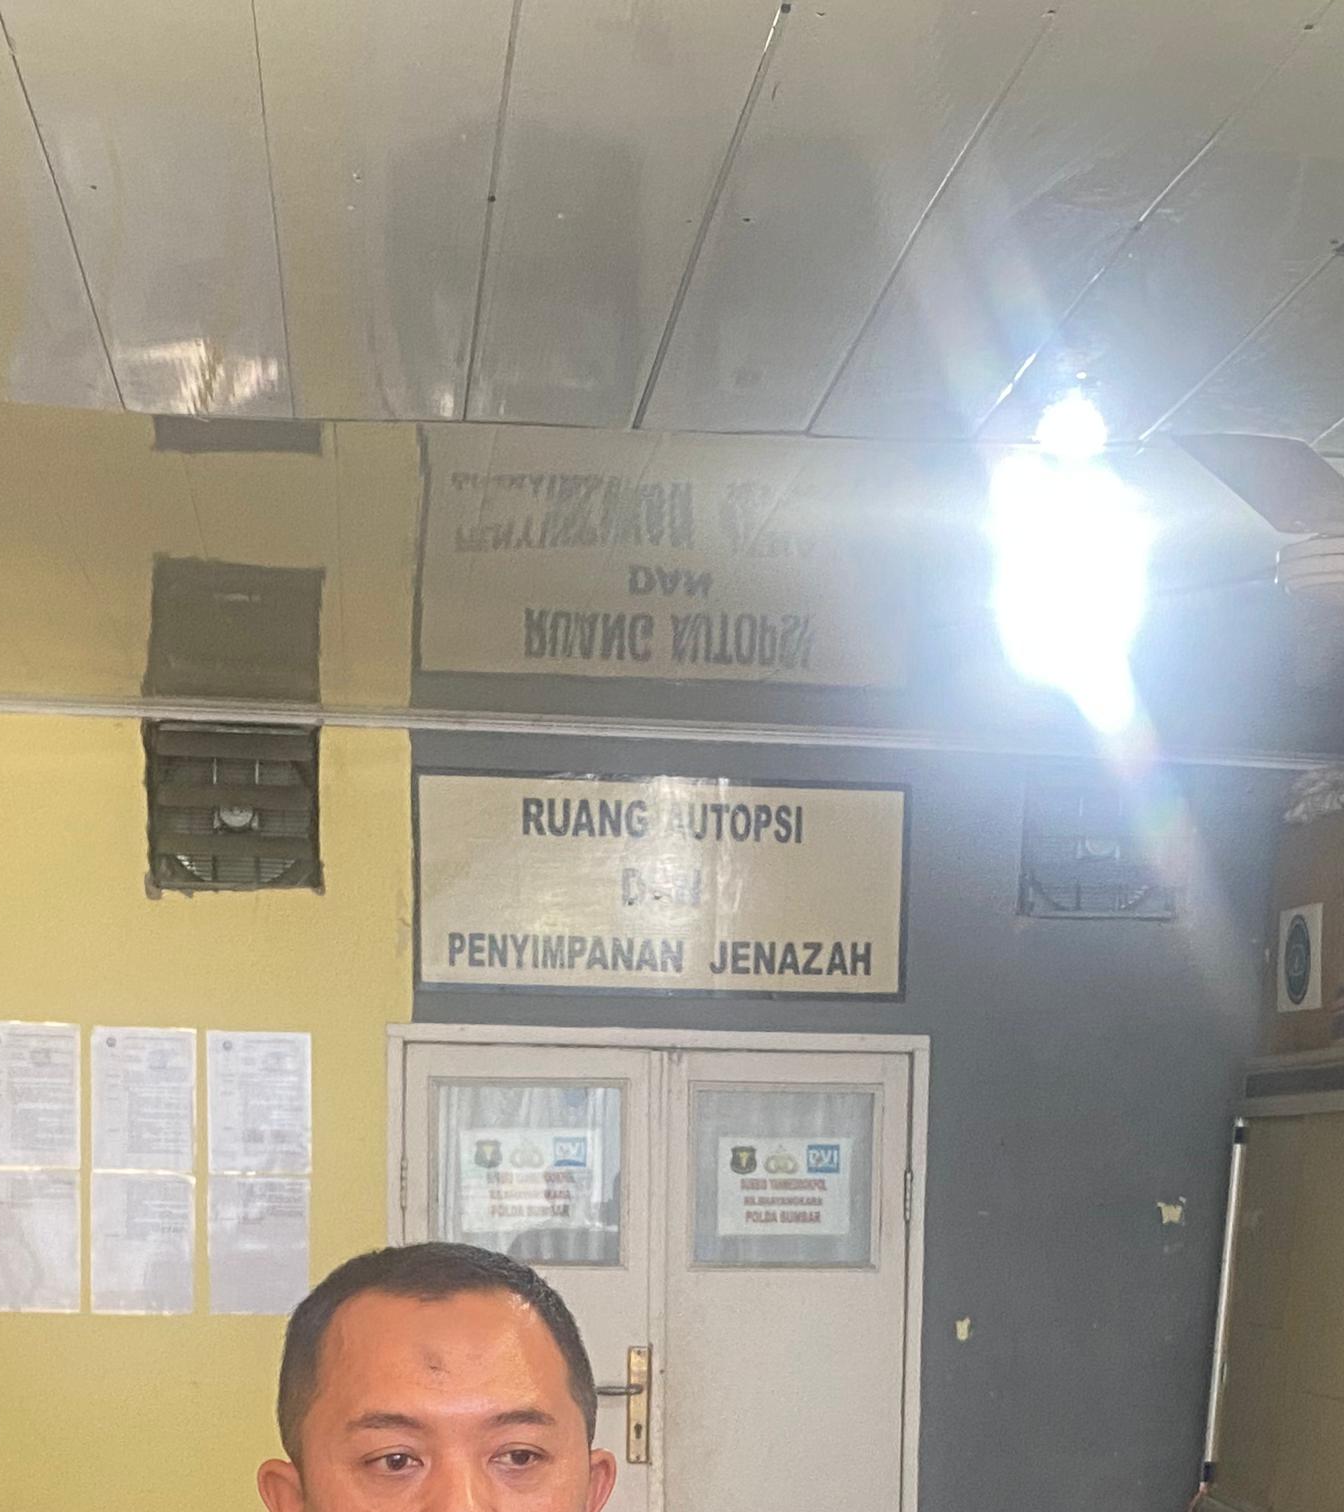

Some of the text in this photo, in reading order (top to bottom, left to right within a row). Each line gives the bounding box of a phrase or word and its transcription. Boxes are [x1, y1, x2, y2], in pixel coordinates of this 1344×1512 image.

[522, 796, 649, 838] RUANG
[621, 867, 701, 907] DN
[448, 931, 873, 976] PENYIMPANAN JENAZAH
